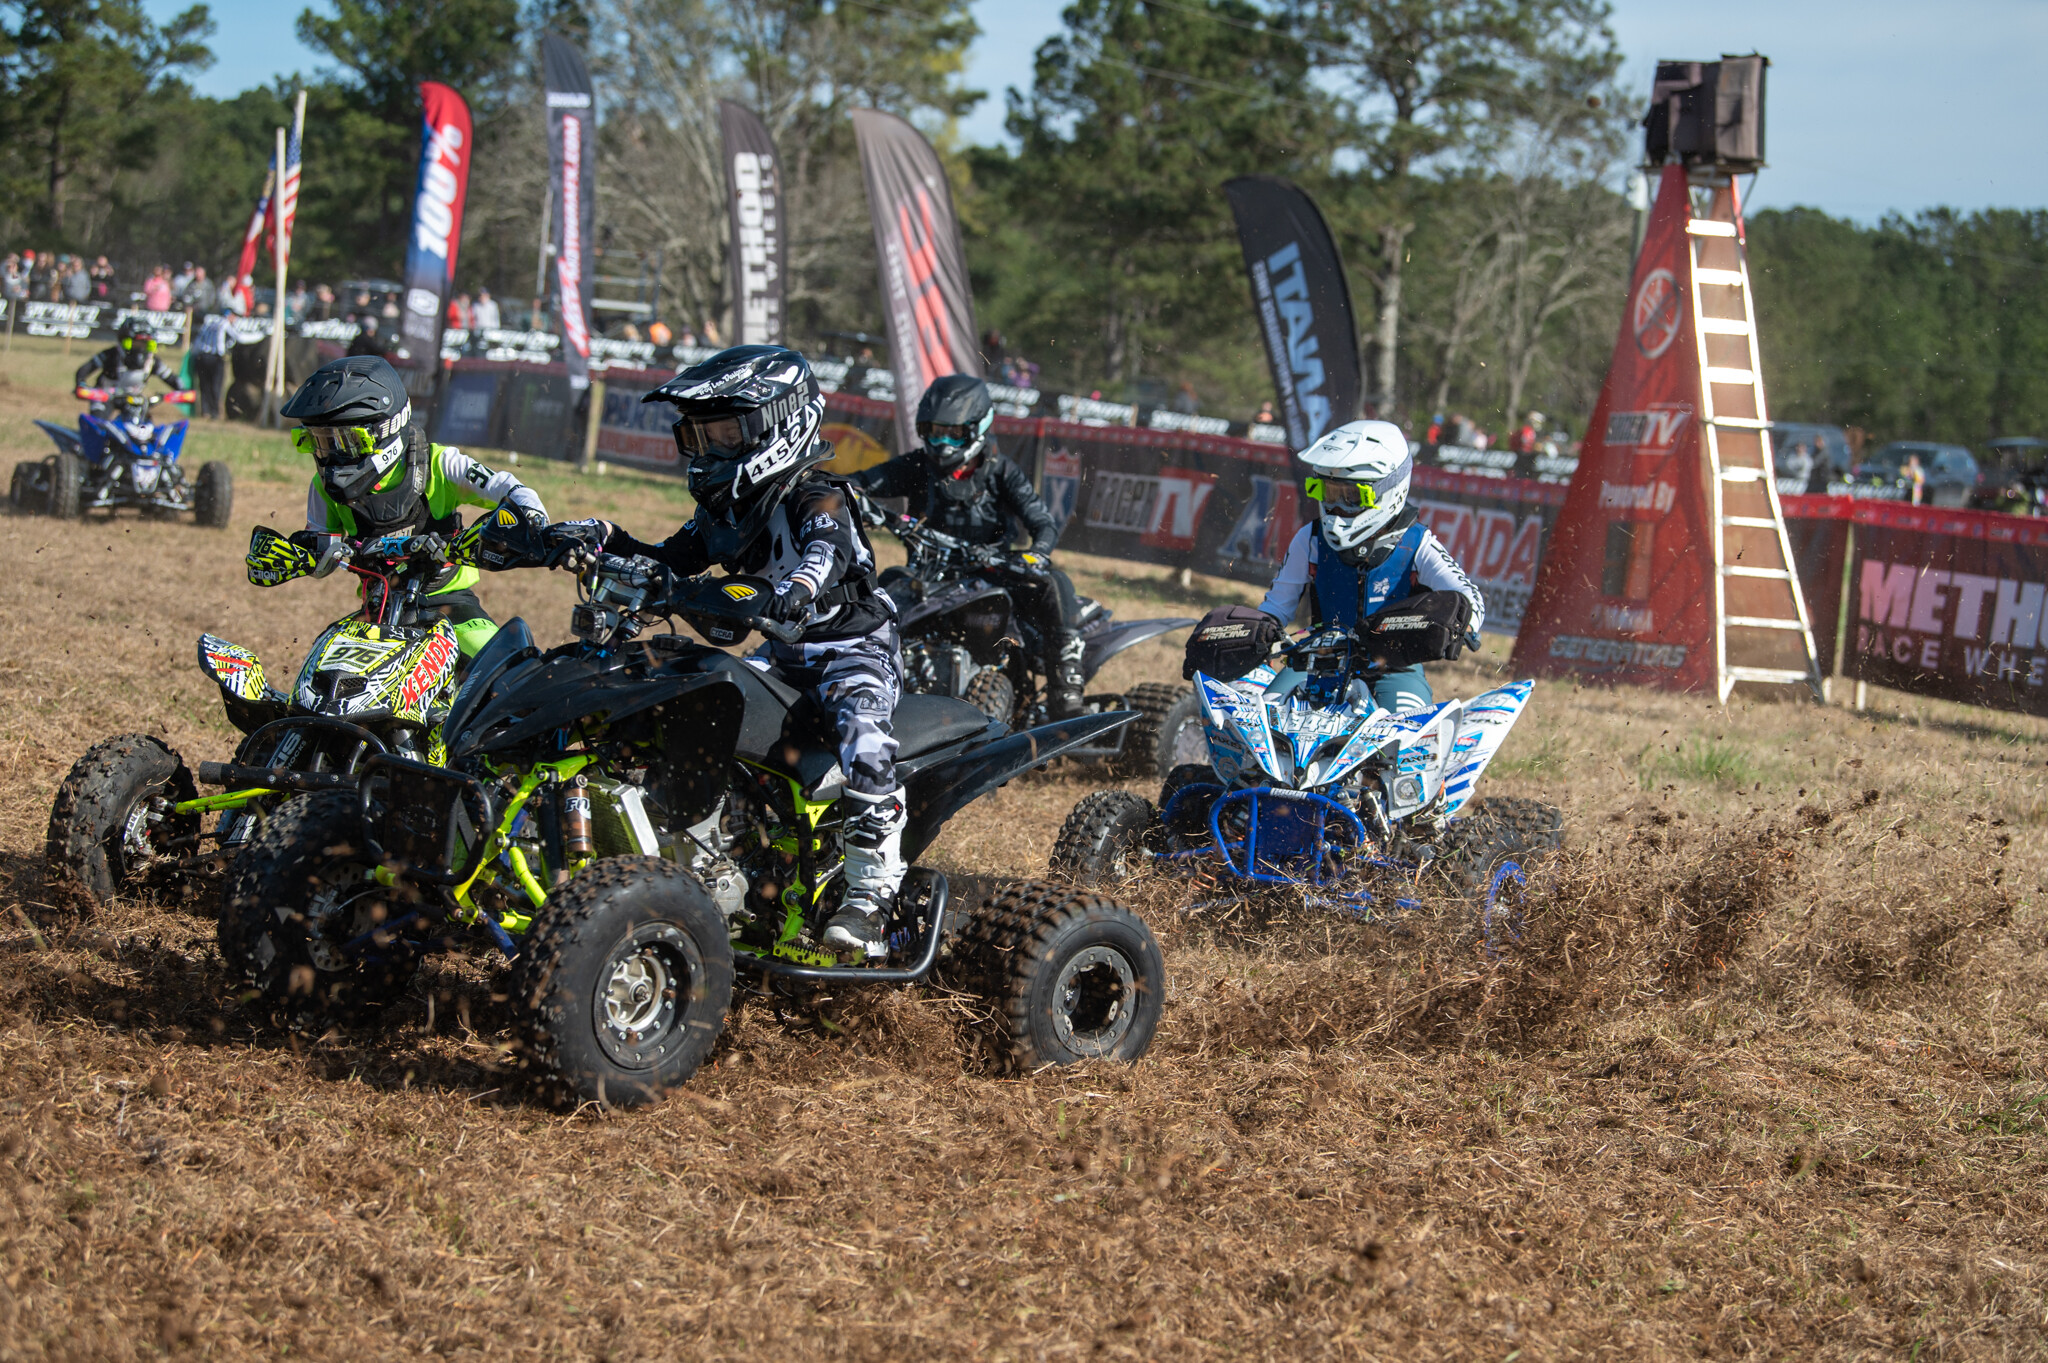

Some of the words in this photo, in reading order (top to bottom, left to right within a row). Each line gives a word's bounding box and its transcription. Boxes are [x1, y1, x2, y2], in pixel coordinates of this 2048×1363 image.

[416, 123, 465, 260] 100%
[381, 445, 398, 465] 976
[751, 444, 790, 478] 415
[1419, 504, 1540, 586] ENDA
[1858, 558, 2048, 651] METH
[1201, 623, 1245, 635] MOOSE
[1381, 615, 1425, 625] MOOSE
[1384, 621, 1430, 632] RACING
[710, 627, 734, 641] CYCRA
[1205, 629, 1251, 641] RACING
[324, 646, 383, 665] 976
[401, 633, 454, 713] KENDA
[564, 796, 592, 819] FO
